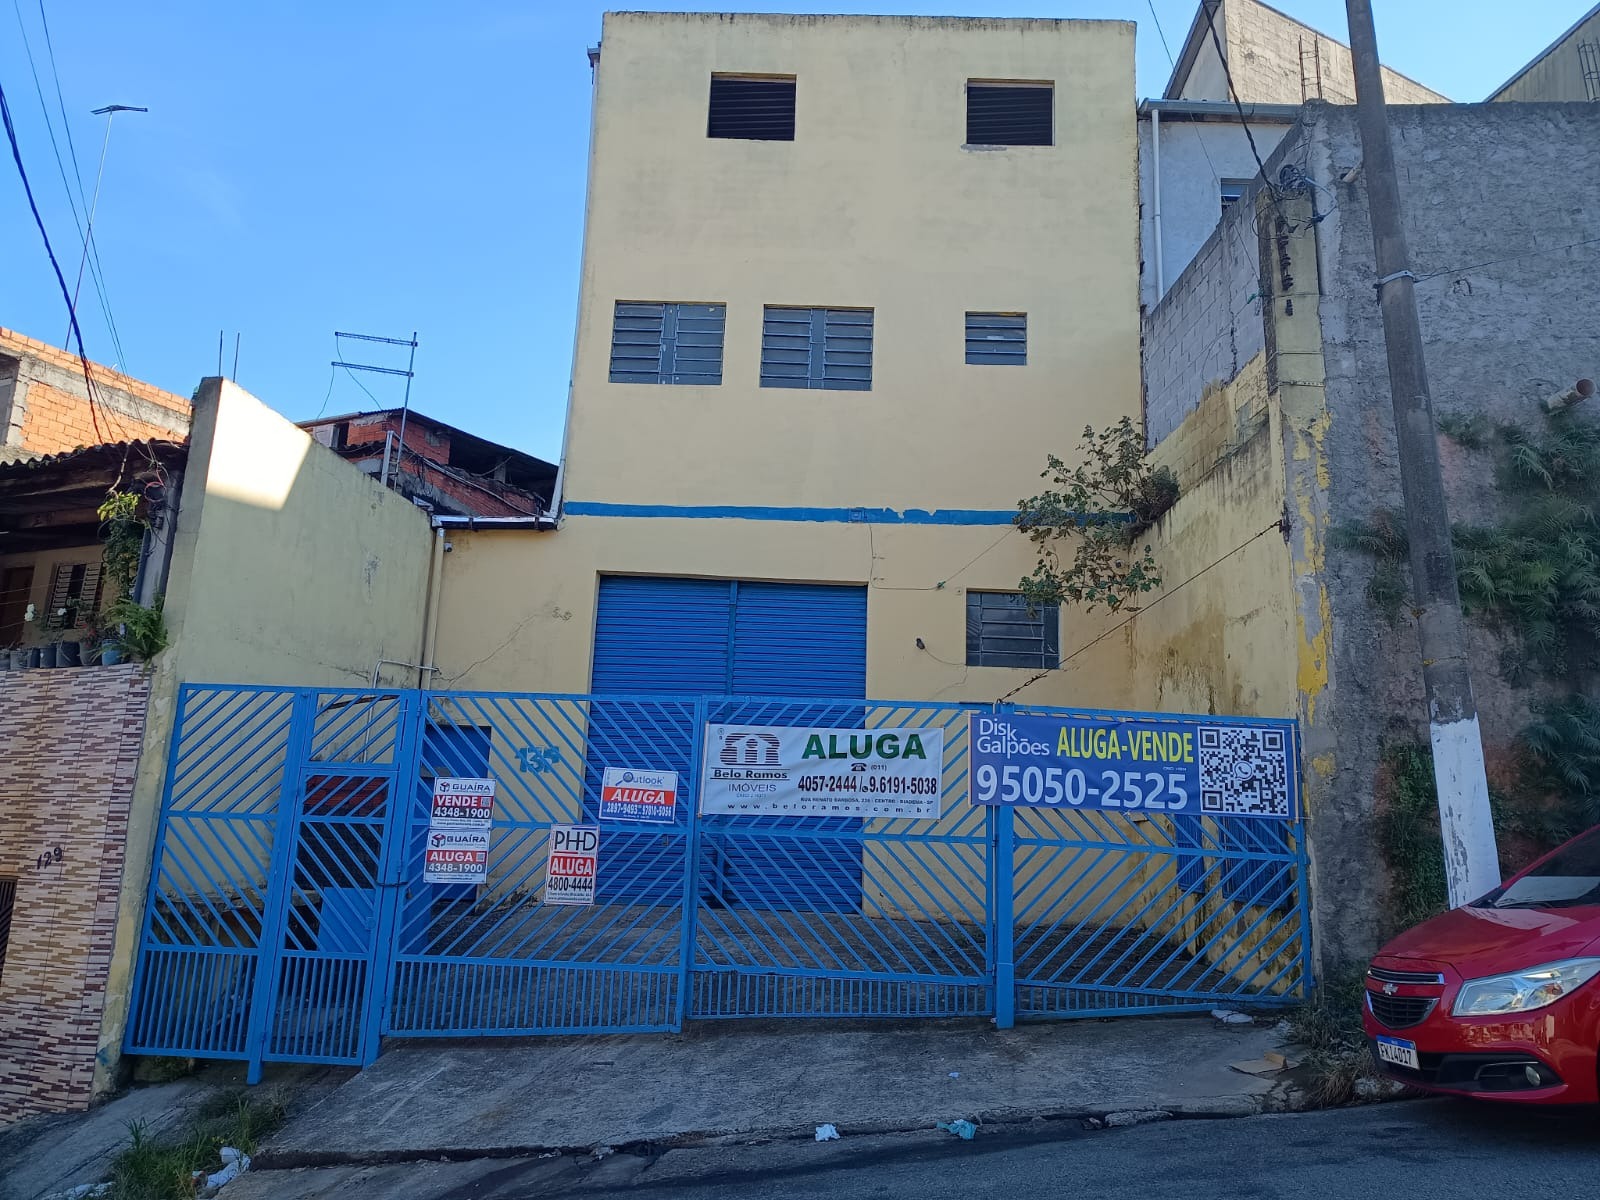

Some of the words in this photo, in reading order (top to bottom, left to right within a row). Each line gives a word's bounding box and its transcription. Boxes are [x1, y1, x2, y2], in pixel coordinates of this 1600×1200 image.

[979, 718, 1017, 742] Disk
[801, 733, 927, 760] ALUGA
[976, 736, 1050, 759] Galpões
[1056, 726, 1194, 763] ALUGA-VENDE
[713, 769, 741, 778] Belo
[745, 770, 788, 779] Ramos
[452, 782, 491, 792] GUAÍRA
[798, 776, 857, 792] 4057-2444
[976, 764, 1188, 810] 95050-2525
[436, 795, 478, 807] VENDE
[611, 788, 666, 804] ALUGA
[434, 806, 491, 818] 4348-1900
[446, 834, 487, 843] GUAÍRA
[554, 830, 597, 851] PHD
[430, 851, 474, 862] ALUGA
[428, 863, 483, 873] 4348-1900
[550, 857, 593, 875] ALUGA
[547, 876, 593, 892] 4800-4444
